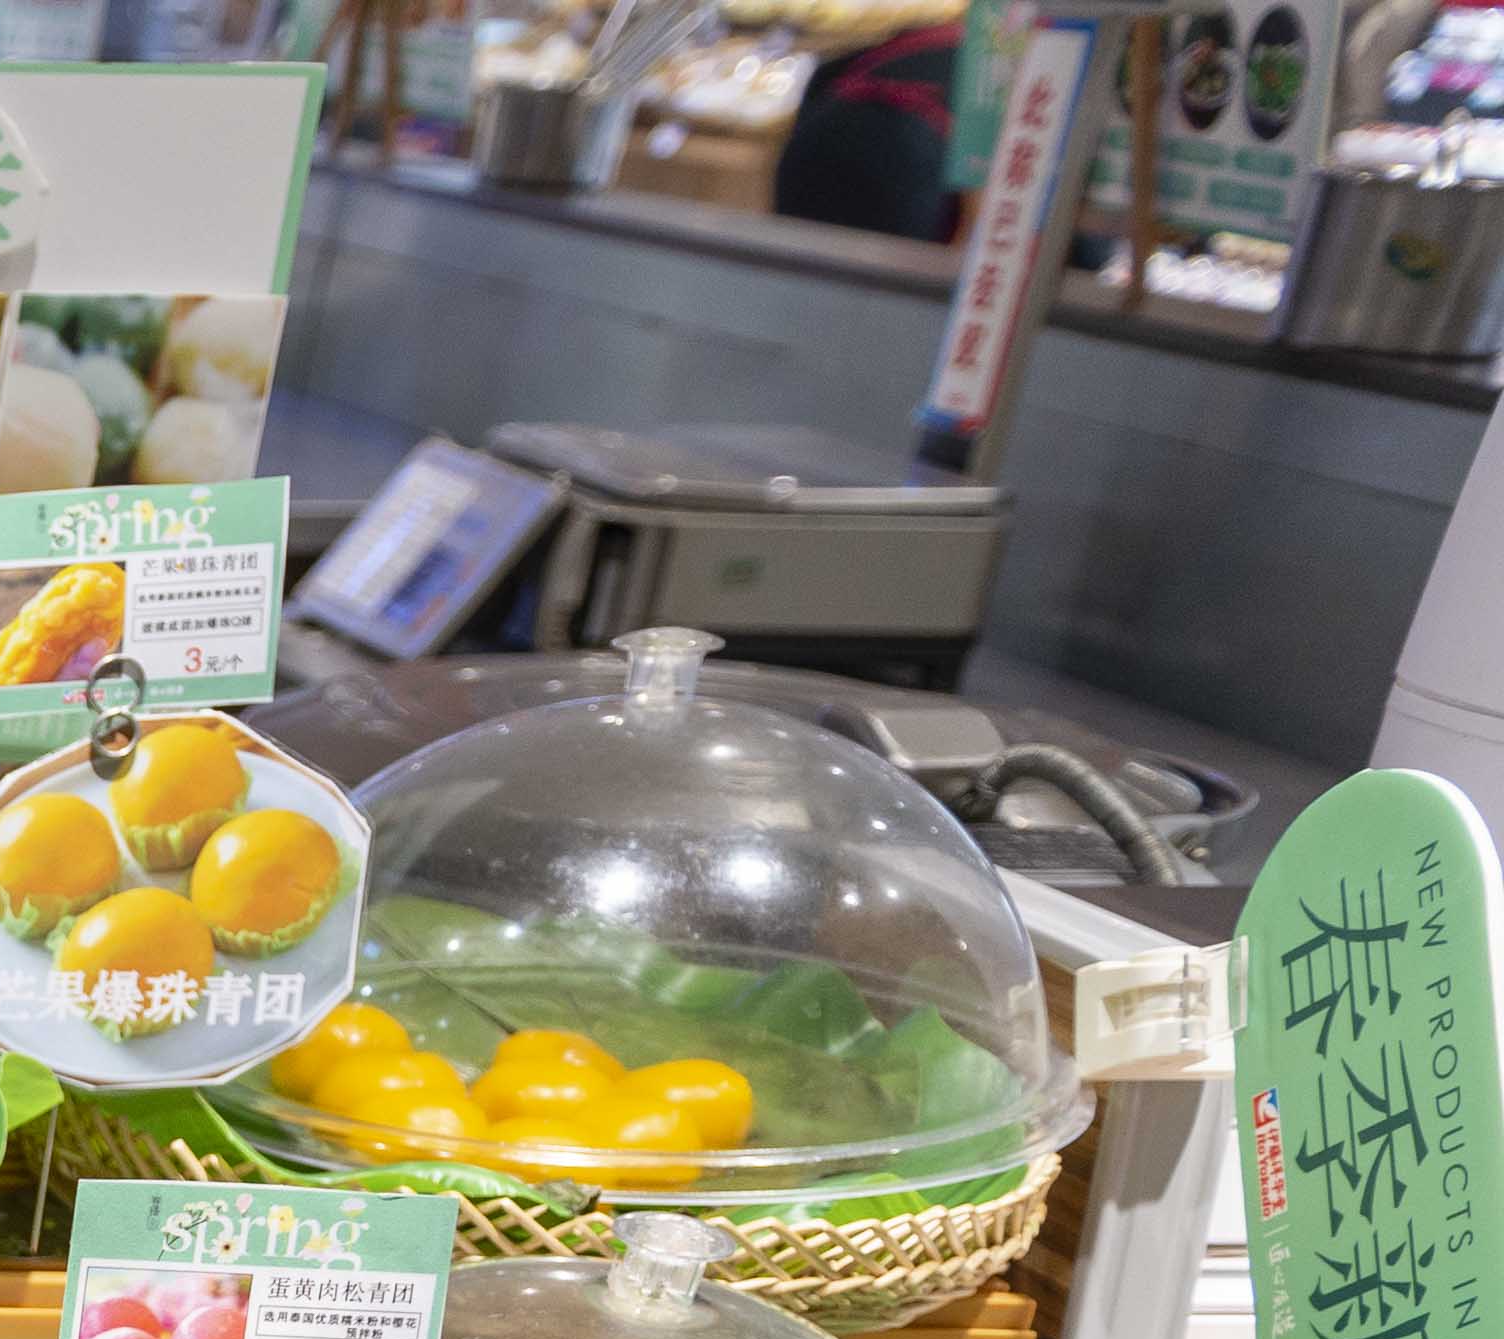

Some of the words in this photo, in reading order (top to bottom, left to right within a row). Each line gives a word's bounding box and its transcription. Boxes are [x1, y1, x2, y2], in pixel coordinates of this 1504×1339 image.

[49, 497, 216, 556] spring
[1414, 840, 1448, 951] NEW
[1425, 980, 1475, 1255] PRODUCTS
[1258, 1158, 1271, 1217] Yokado
[1267, 1127, 1287, 1212] 伊藤洋华堂
[160, 1195, 369, 1272] spring
[267, 1275, 416, 1305] 蛋黄肉松青团
[1451, 1282, 1480, 1330] IN
[263, 1310, 418, 1330] 选用泰国优质糯米粉和樱花
